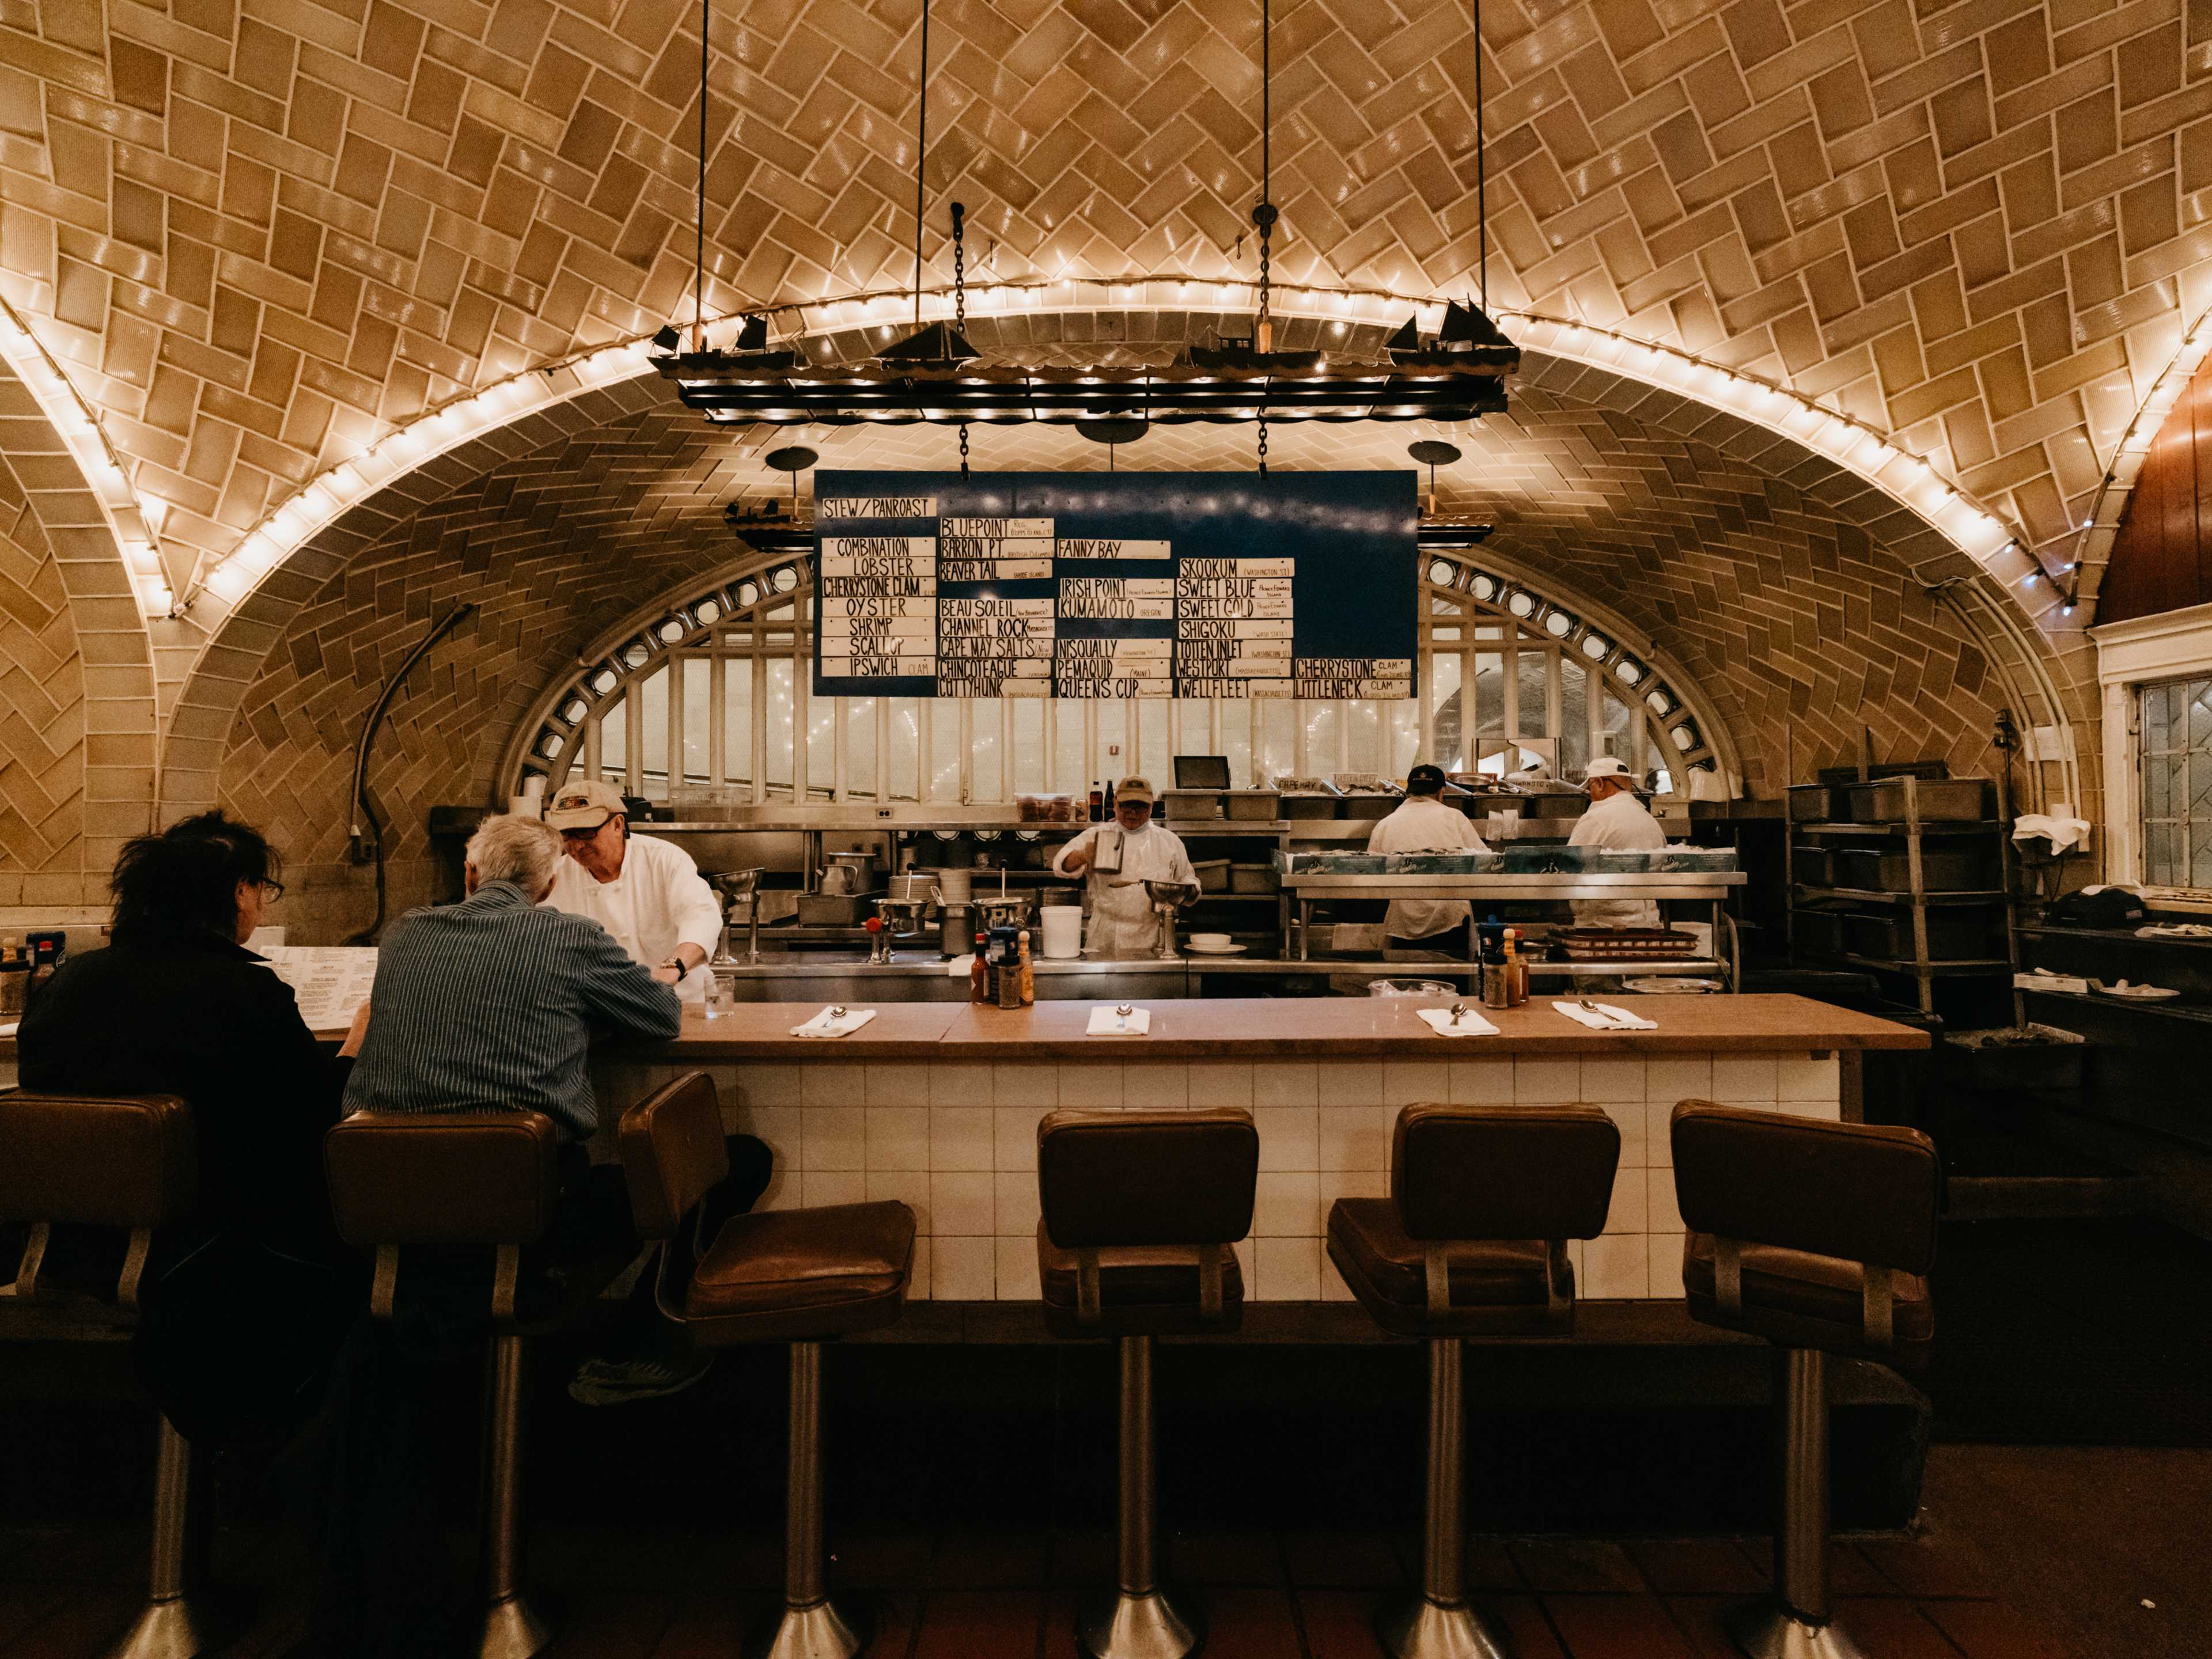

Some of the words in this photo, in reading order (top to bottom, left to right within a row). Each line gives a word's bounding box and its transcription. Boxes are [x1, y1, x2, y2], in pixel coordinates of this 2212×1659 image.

[941, 518, 1010, 537] BLUEPOINT
[837, 538, 909, 556] COMBINATION
[941, 539, 983, 558] BARRON
[990, 539, 1004, 558] PT.
[1059, 540, 1096, 558] FANNY
[1098, 541, 1122, 558] BAY
[854, 558, 914, 576] LOBSTER
[940, 562, 976, 581] BEAVER
[978, 561, 1001, 579] TAIL
[1181, 559, 1237, 578] SKOOKUM
[823, 577, 890, 597] CHERRYSTONE
[893, 577, 920, 596] CLAM
[1062, 579, 1091, 598] IRISH
[1094, 579, 1127, 598] POINT
[1179, 579, 1220, 598] SWEET
[1225, 579, 1256, 598] BLUE
[846, 598, 906, 616] OYSTER
[941, 600, 972, 617] BEAU
[975, 600, 1016, 617] SOLEIL
[1060, 599, 1134, 618] KUMAMOTO
[1140, 609, 1161, 617] OREGON
[1180, 599, 1220, 618] SWEET
[1224, 599, 1253, 618] GOLD
[849, 618, 893, 636] SHRIMP
[941, 619, 992, 637] CHANNEL
[997, 619, 1029, 637] ROCK
[1181, 620, 1235, 638] SHIGOKU
[849, 637, 904, 656] SCALLOP
[941, 638, 967, 657] CAPE
[971, 638, 992, 657] MAY
[996, 639, 1035, 657] SALTS
[1059, 639, 1118, 658] NISQUALLY
[1181, 640, 1214, 658] TOTTEN
[1217, 640, 1243, 658] INLET
[850, 657, 898, 676] IPSWICH
[908, 664, 929, 675] CLAM
[940, 660, 1018, 678] CHINCOTEAGUE
[1058, 659, 1113, 679] PEMAQUID
[1130, 668, 1151, 678] (MAINE)
[1177, 658, 1232, 677] WESTPORT
[1297, 659, 1377, 679] CHERRYSTONE
[1378, 661, 1397, 669] CLAM
[939, 679, 1004, 698] CUTTYHUNK
[1059, 679, 1111, 699] QUEENS
[1116, 679, 1139, 699] CUP
[1181, 679, 1251, 698] WELLFLEET
[1296, 679, 1363, 699] LITTLENECK
[1371, 681, 1393, 690] CLAM
